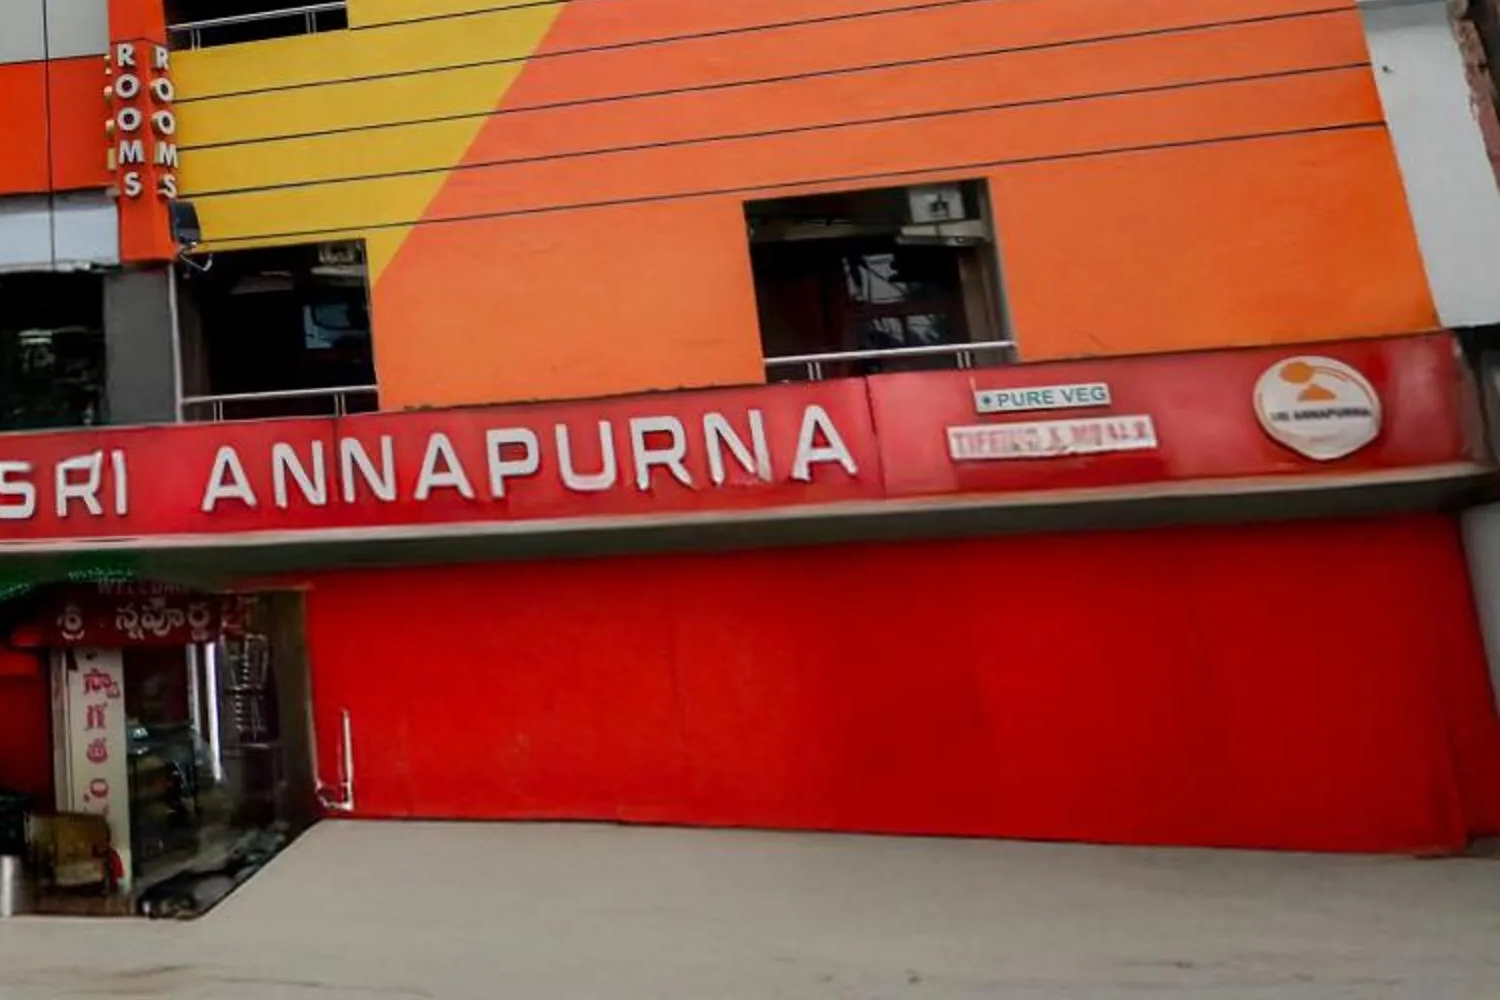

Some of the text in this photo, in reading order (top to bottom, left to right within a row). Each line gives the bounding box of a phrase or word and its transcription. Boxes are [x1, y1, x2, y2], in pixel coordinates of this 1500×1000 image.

[114, 42, 145, 197] ROOMS
[150, 45, 179, 199] ROOMS
[200, 404, 858, 513] ANNAPURNA
[996, 385, 1107, 408] PURE VEG
